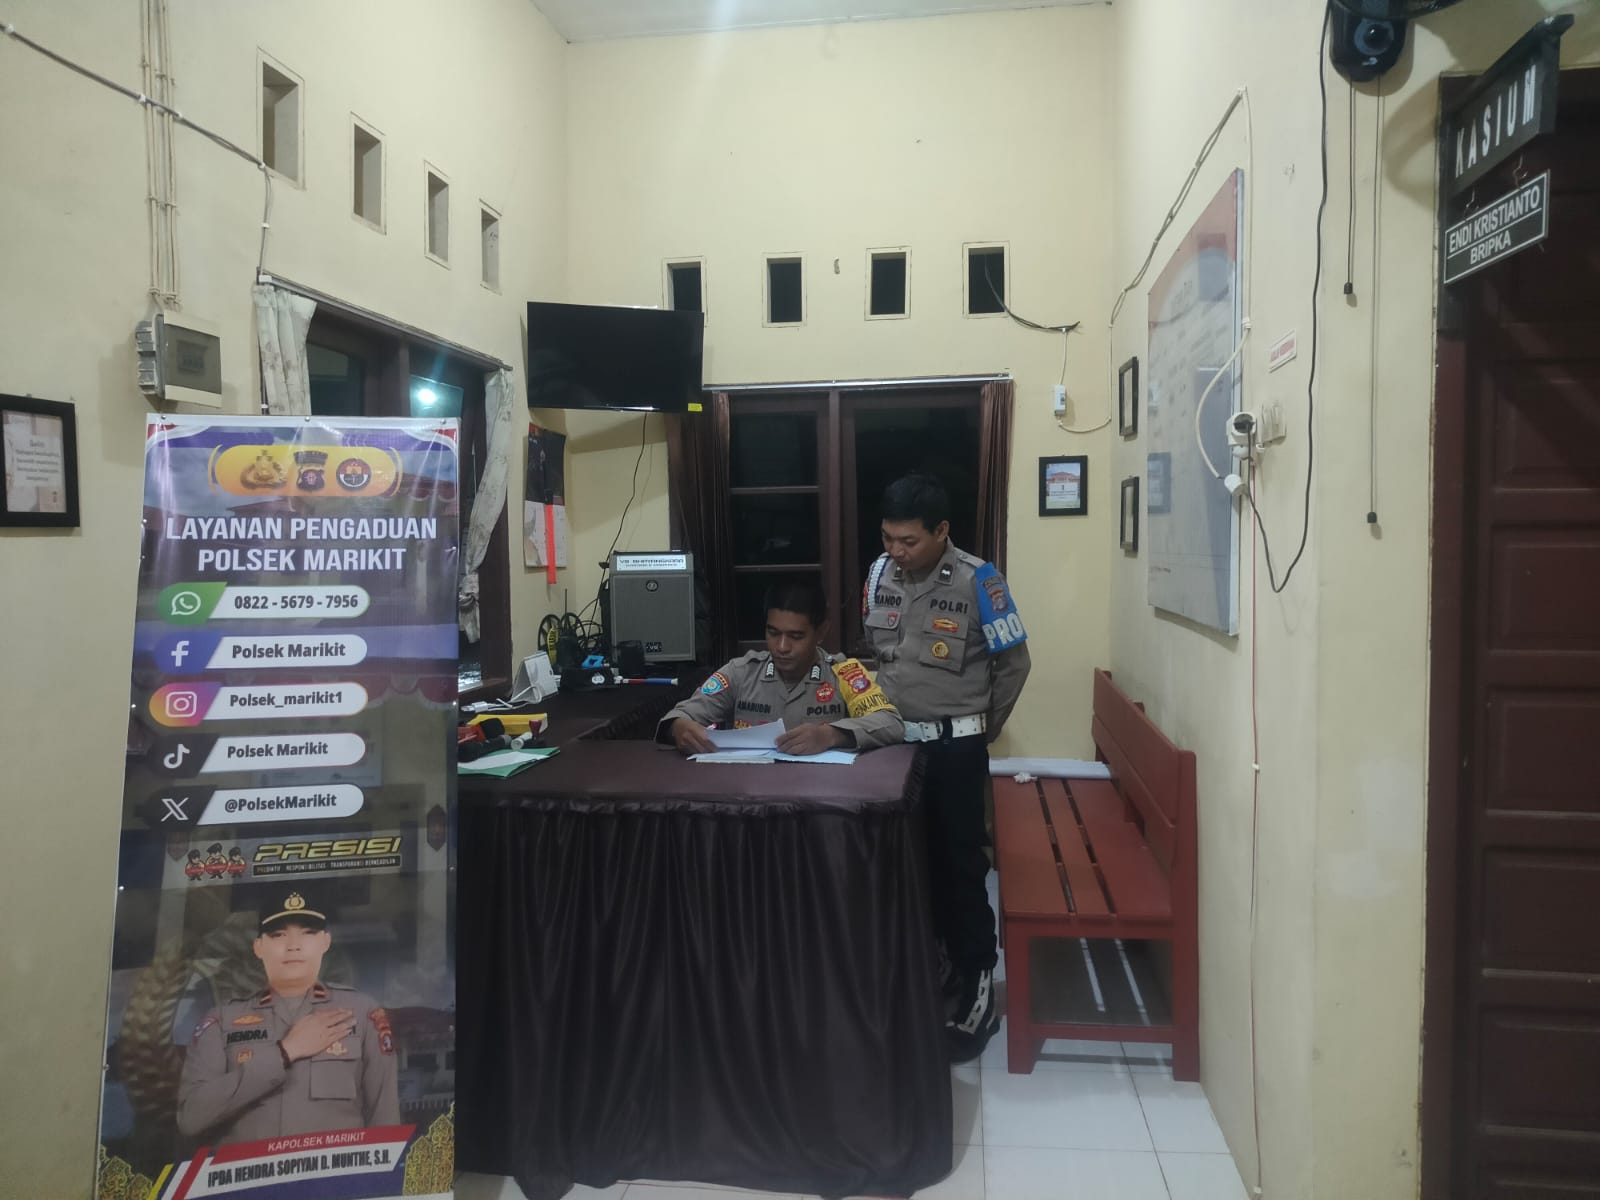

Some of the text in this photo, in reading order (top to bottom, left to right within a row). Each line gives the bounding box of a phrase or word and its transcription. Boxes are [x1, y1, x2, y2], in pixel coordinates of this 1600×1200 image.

[1455, 64, 1537, 179] KASIUM
[1449, 186, 1541, 254] ENDI KRISTIANTO
[1469, 230, 1512, 265] BRIPKA
[165, 517, 437, 540] LAYANAN PENGADUAN
[198, 547, 407, 572] POLSEK MARIKIT
[234, 595, 269, 610] 0822
[280, 594, 314, 610] 5679
[325, 594, 359, 609] 7956
[930, 598, 969, 615] POLRI
[232, 642, 346, 659] Polsek Marikit
[229, 691, 343, 709] Polsek_marikit1
[806, 703, 842, 717] POLRI
[227, 742, 329, 760] Polsek Marikit
[224, 793, 337, 813] @PolsekMarikit
[253, 836, 402, 863] PRESISI
[226, 1028, 268, 1044] HENDRA
[267, 1131, 366, 1152] KAPOLSEK MARIKIT
[208, 1149, 391, 1188] IPDA HENDRA SOPIYAN D. MUNTHE, S.H.
